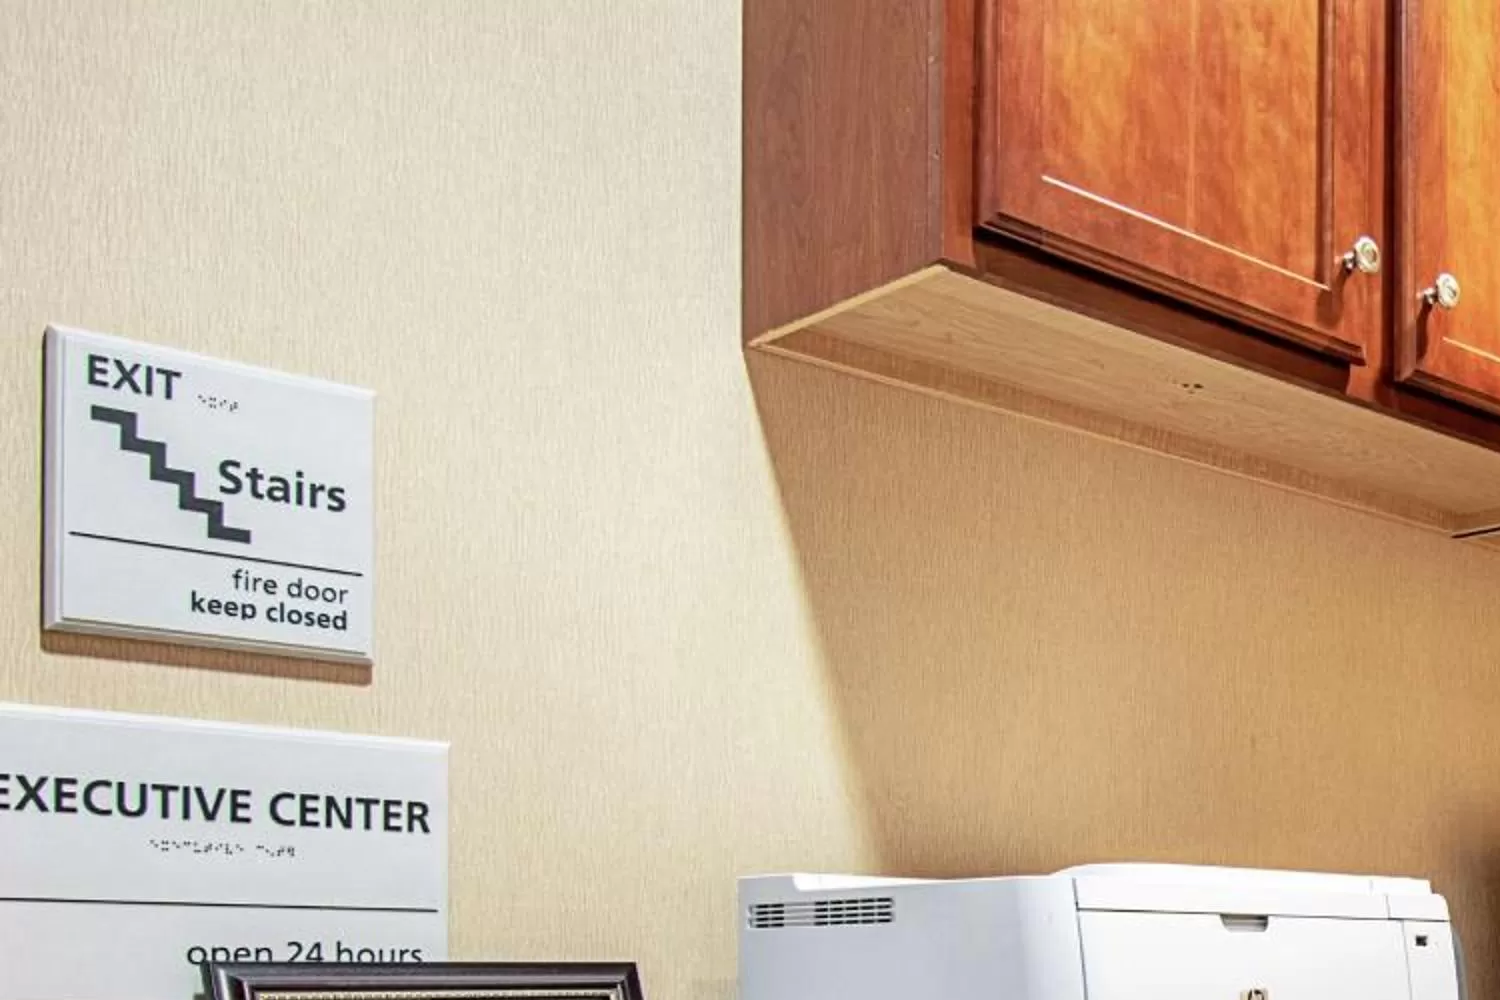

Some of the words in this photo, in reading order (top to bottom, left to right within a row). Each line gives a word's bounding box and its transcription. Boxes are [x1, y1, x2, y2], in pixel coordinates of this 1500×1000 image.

[87, 353, 182, 400] EXIT
[218, 459, 347, 513] Stairs
[232, 568, 278, 595] fire
[287, 578, 349, 604] door
[191, 590, 257, 620] keep
[266, 602, 348, 631] closed
[269, 791, 431, 834] CENTER
[287, 940, 324, 963] 24
[336, 940, 423, 963] hours
